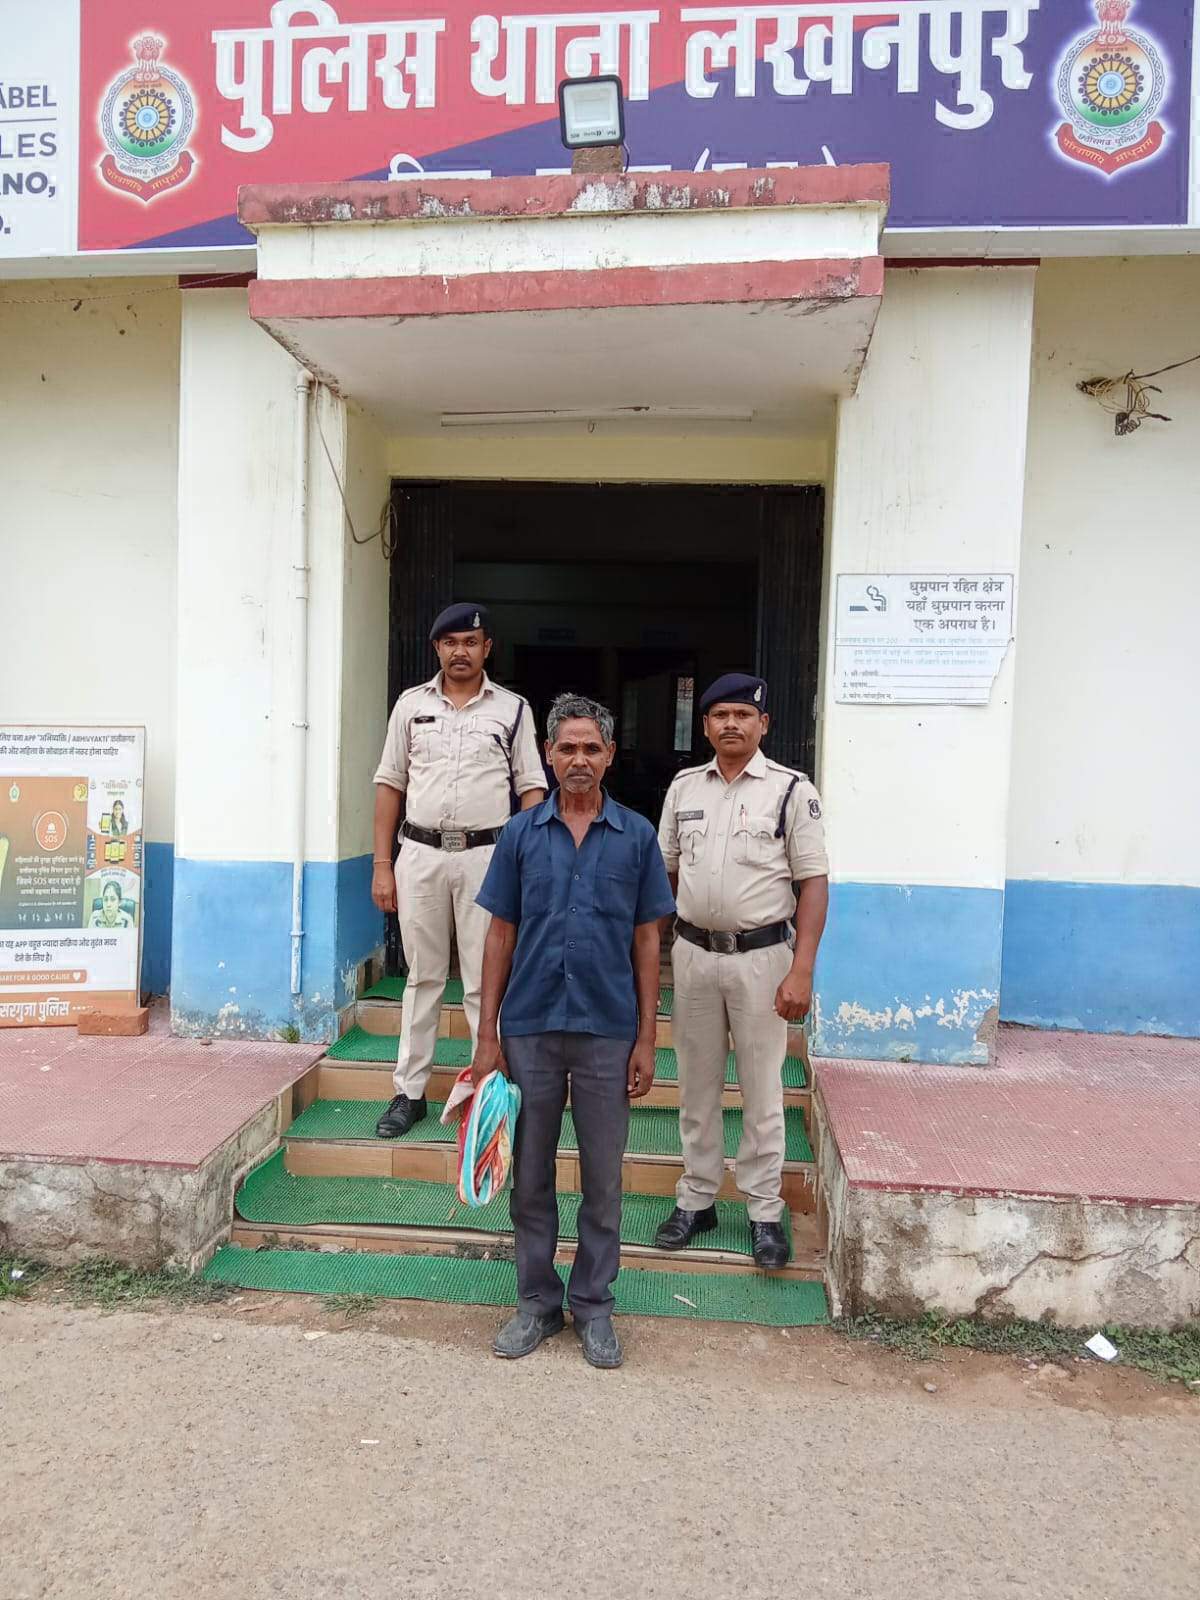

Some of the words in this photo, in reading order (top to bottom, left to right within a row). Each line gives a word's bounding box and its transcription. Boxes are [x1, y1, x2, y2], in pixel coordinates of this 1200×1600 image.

[211, 0, 446, 152] पुलिस
[471, 9, 661, 105] थाना
[680, 0, 1040, 130] लखनपुर
[952, 578, 977, 593] रहित
[982, 577, 1005, 593] क्षेत्र
[974, 599, 1005, 612] करना
[913, 618, 934, 633] एक
[938, 618, 977, 631] अपराध
[45, 835, 58, 843] SOS
[0, 1002, 37, 1024] सरगुजा
[38, 996, 71, 1024] पुलिस
